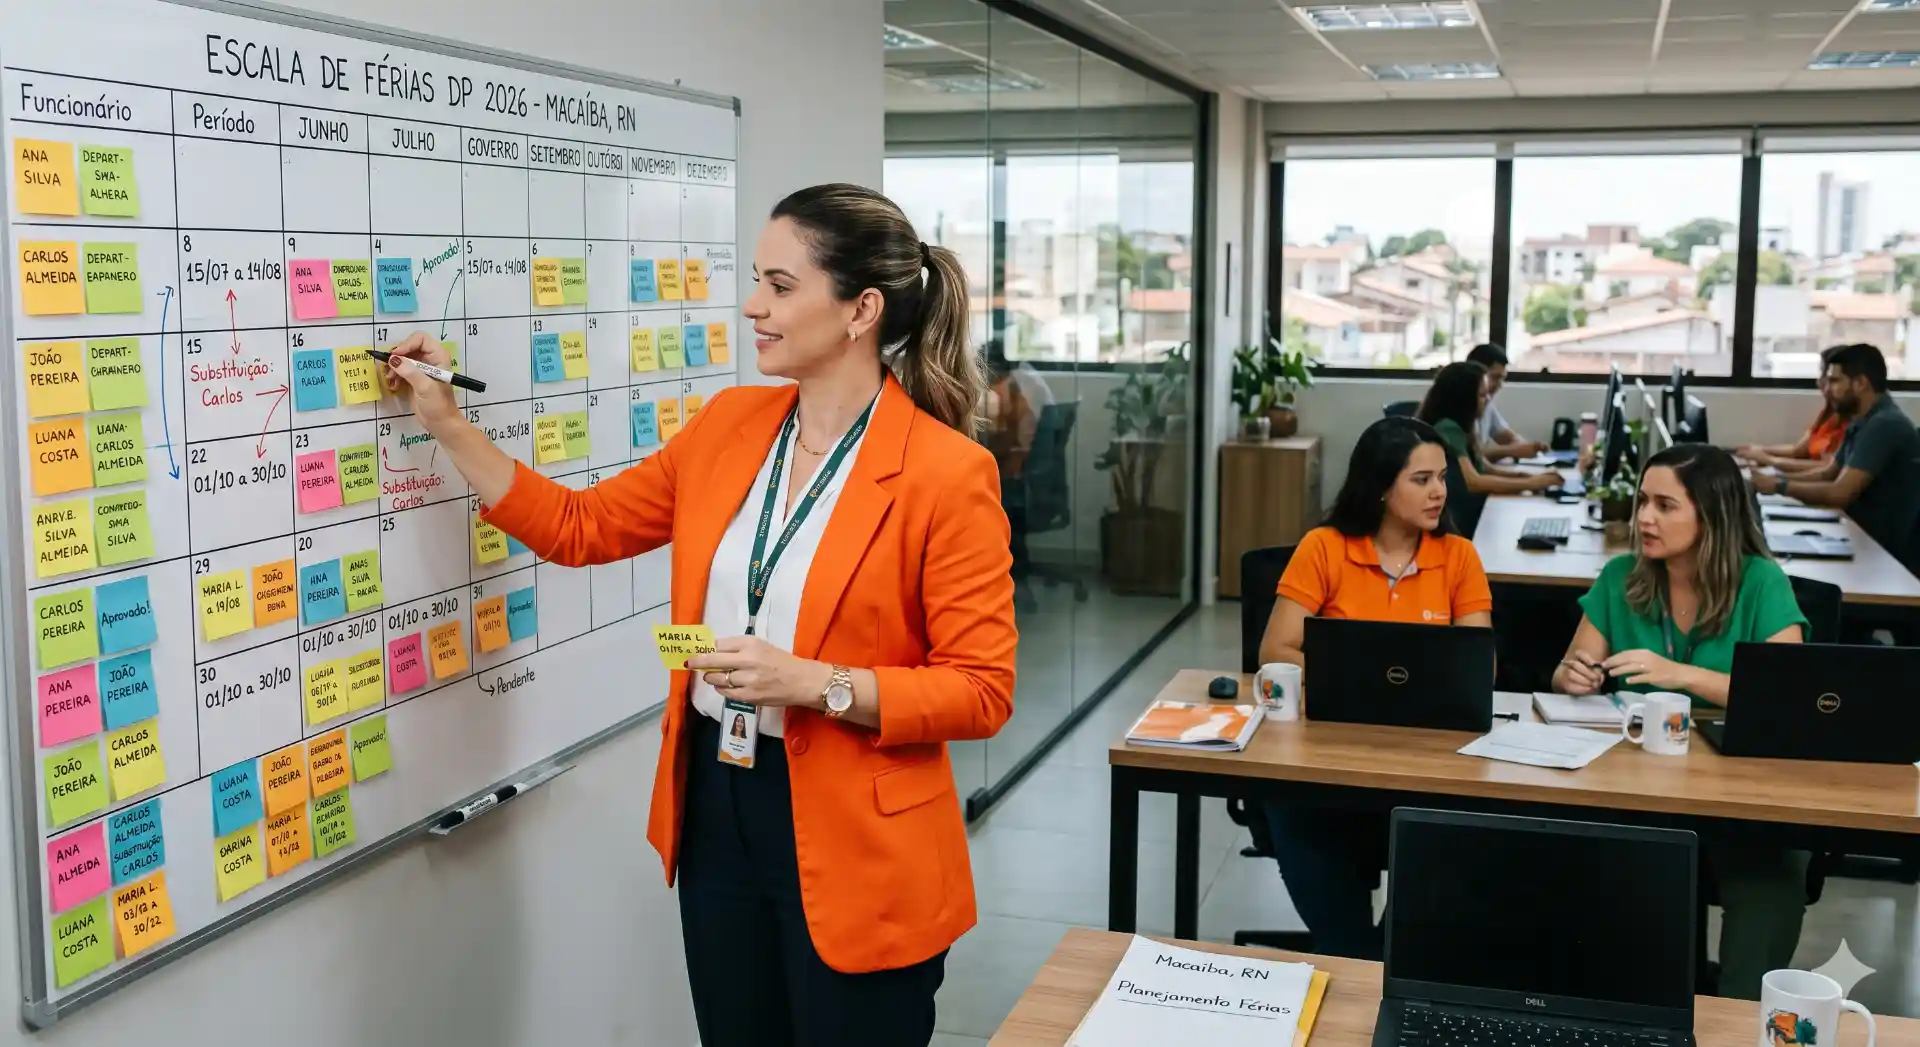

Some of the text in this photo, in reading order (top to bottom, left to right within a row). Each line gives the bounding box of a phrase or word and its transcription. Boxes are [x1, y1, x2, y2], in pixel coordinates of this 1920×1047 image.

[207, 34, 305, 86] ESCALA
[322, 56, 349, 91] DE
[365, 54, 434, 103] FÉRIAS
[448, 76, 473, 107] DP
[486, 81, 528, 118] 2026
[546, 91, 612, 134] MACAÍBA,
[618, 108, 636, 132] RN
[21, 84, 132, 121] Funcionário
[193, 103, 255, 134] Período
[299, 116, 348, 142] JUNHO
[392, 128, 435, 151] JULHO
[22, 149, 48, 162] ANA
[83, 150, 124, 164] DEPART-
[468, 138, 519, 160] GOVERRO
[530, 145, 581, 167] SETEMBRO
[632, 157, 676, 175] NOVEMBRO
[24, 171, 61, 187] SILVA
[90, 188, 129, 201] ALHERA
[183, 235, 192, 252] 8
[289, 238, 296, 252] 9
[375, 239, 382, 253] 4
[467, 241, 473, 254] 5
[532, 243, 537, 254] 6
[588, 244, 592, 256] 7
[631, 245, 634, 256] 8
[23, 250, 68, 263] CARLOS
[87, 253, 129, 264] DEPART-
[186, 259, 281, 285] 15/07 a 14/08
[295, 268, 312, 277] ANA
[468, 257, 526, 276] 15/07 a 14/08
[26, 272, 77, 284] ALMEIDA
[298, 284, 322, 293] SILVA
[468, 324, 478, 336] 18
[534, 320, 542, 332] 13
[589, 318, 597, 328] 14
[292, 333, 304, 347] 16
[378, 329, 388, 341] 17
[91, 346, 131, 359] DEPART-
[187, 339, 202, 355] 15
[190, 358, 274, 382] Substituição:
[297, 359, 326, 371] CARLOS
[31, 372, 79, 385] PEREIRA
[202, 386, 243, 407] Carlos
[590, 396, 598, 406] 21
[535, 402, 544, 413] 23
[470, 411, 479, 423] 25
[36, 429, 75, 444] LUANA
[380, 424, 391, 436] 29
[499, 431, 505, 439] a
[96, 440, 134, 453] CARLOS
[296, 435, 309, 448] 23
[40, 448, 79, 463] COSTA
[98, 456, 143, 471] ALMEIDA
[191, 448, 206, 464] 22
[301, 461, 325, 472] LUANA
[194, 461, 286, 494] 01/10 a 30/10
[302, 476, 335, 489] PEREIRA
[345, 478, 373, 489] ALMEIDA
[382, 473, 445, 494] Substituição:
[591, 473, 600, 484] 25
[392, 495, 424, 510] Carlos
[383, 518, 394, 531] 25
[45, 528, 76, 542] SILVA
[108, 533, 136, 546] SILVA
[299, 537, 312, 551] 20
[40, 544, 89, 563] ALMEIDA
[195, 558, 209, 574] 29
[352, 574, 370, 585] SILVA
[202, 580, 243, 597] MARIA L.
[307, 587, 340, 603] PEREIRA
[40, 600, 84, 619] CARLOS
[216, 596, 240, 613] 19/08
[101, 600, 151, 628] Aprovado!
[388, 608, 418, 631] 01/10
[422, 612, 428, 620] a
[432, 596, 458, 618] 30/10
[42, 620, 85, 640] PEREIRA
[303, 618, 376, 653] 01/10 a 30/10
[109, 664, 136, 683] JOÃO
[200, 667, 216, 684] 30
[497, 667, 535, 695] Pendente
[48, 680, 72, 695] ANA
[108, 680, 149, 702] PEREIRA
[205, 666, 290, 709] 01/10 a 30/10
[45, 694, 91, 717] PEREIRA
[111, 730, 149, 751] CARLOS
[114, 744, 157, 768] ALMEIDA
[271, 756, 292, 772] JOÃO
[52, 774, 97, 799] PEREIRA
[219, 773, 249, 792] LUANA
[268, 769, 301, 790] PEREIRA
[223, 790, 252, 809] COSTA
[114, 807, 150, 829] CARLOS
[268, 815, 291, 830] MARIA
[115, 820, 155, 844] ALMEIDA
[56, 844, 80, 863] ANA
[58, 857, 100, 884] ALMEIDA
[122, 852, 158, 876] CARLOS
[224, 854, 252, 874] COSTA
[118, 886, 146, 906] MARIA
[59, 914, 95, 940] LUANA
[134, 915, 162, 936] 30/22
[63, 934, 98, 959] COSTA
[1241, 968, 1270, 980] RN
[1117, 980, 1291, 1015] Planejamento Férias
[1525, 997, 1546, 1007] DELL
